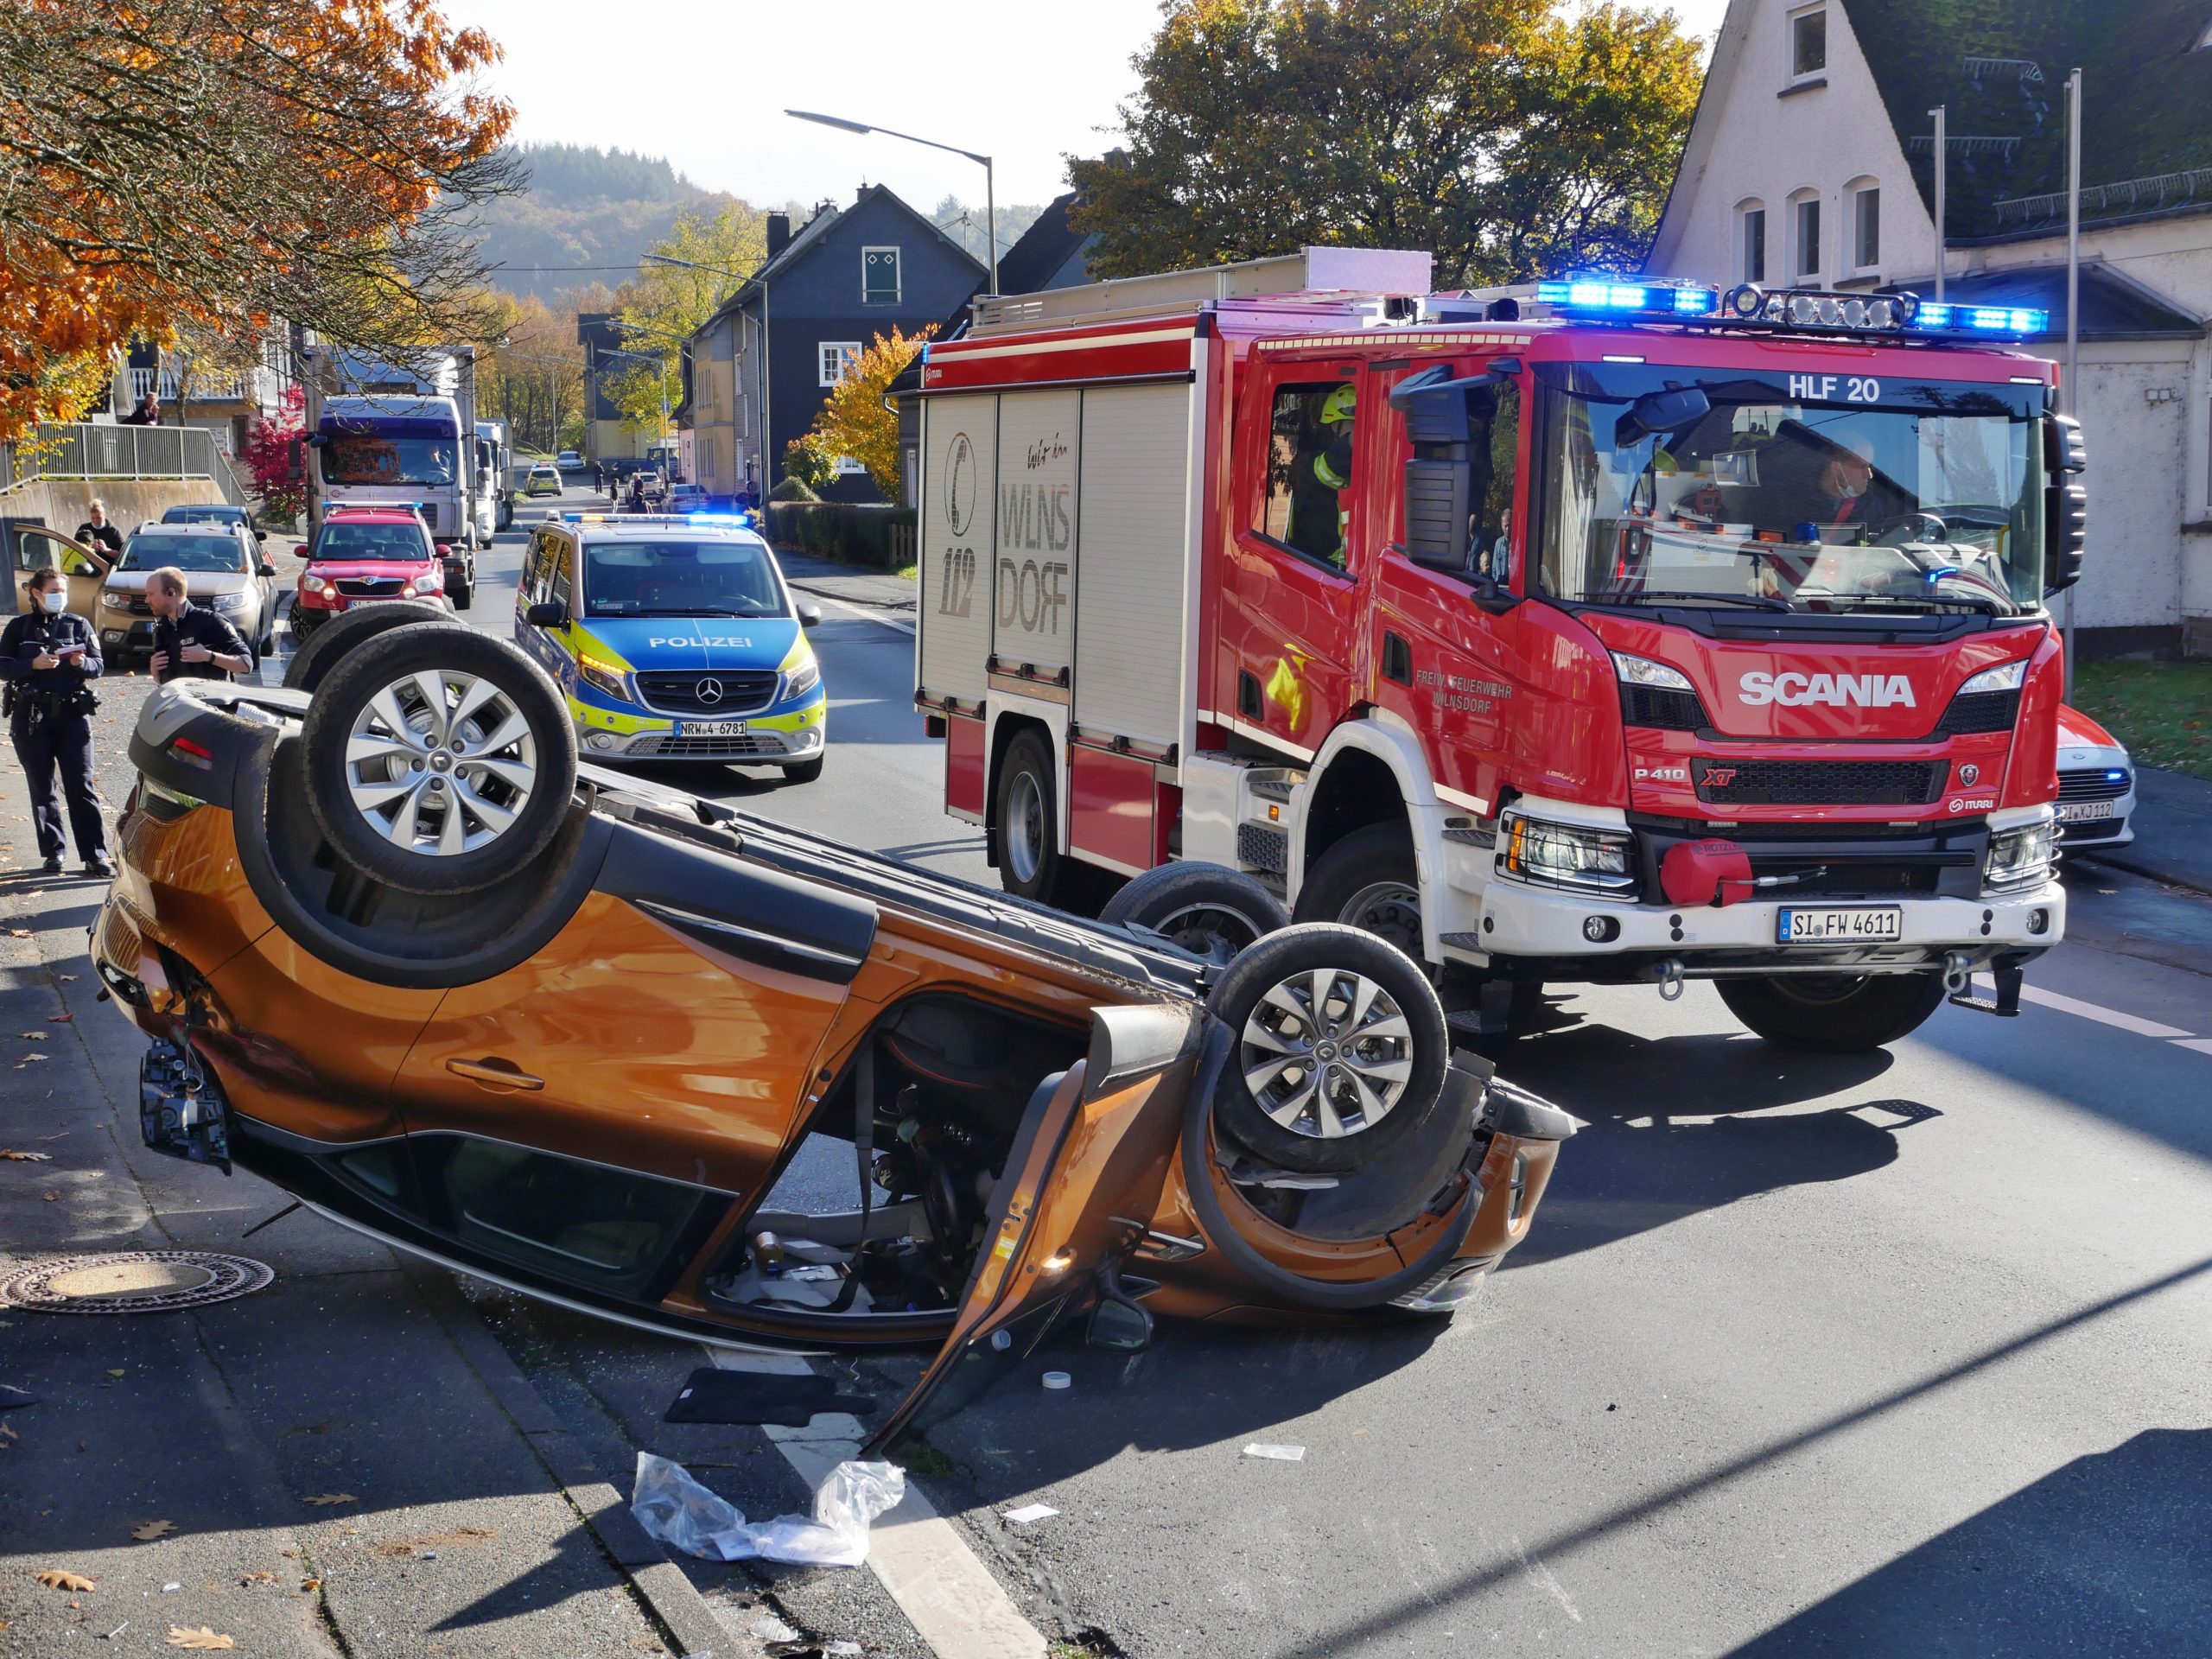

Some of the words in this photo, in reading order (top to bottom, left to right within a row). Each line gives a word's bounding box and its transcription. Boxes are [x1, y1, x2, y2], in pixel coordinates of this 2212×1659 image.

[1789, 374, 1837, 401] HLF
[1847, 377, 1880, 404] 20
[938, 547, 976, 619] 112
[649, 637, 753, 648] POLIZEI
[1416, 670, 1446, 688] FREIW.
[1450, 676, 1513, 699] FEUERWEHR
[1738, 671, 1916, 708] SCANIA
[1433, 690, 1492, 715] WILNSDORF
[681, 723, 701, 735] NRW
[707, 722, 745, 734] 4-6781
[1634, 768, 1649, 780] P
[1649, 768, 1685, 780] 410
[1700, 769, 1737, 787] XT
[1965, 799, 1993, 810] ITURRI
[2094, 804, 2111, 817] 112
[1793, 914, 1813, 936] SI
[1826, 913, 1847, 935] FW
[1853, 913, 1895, 935] 4611
